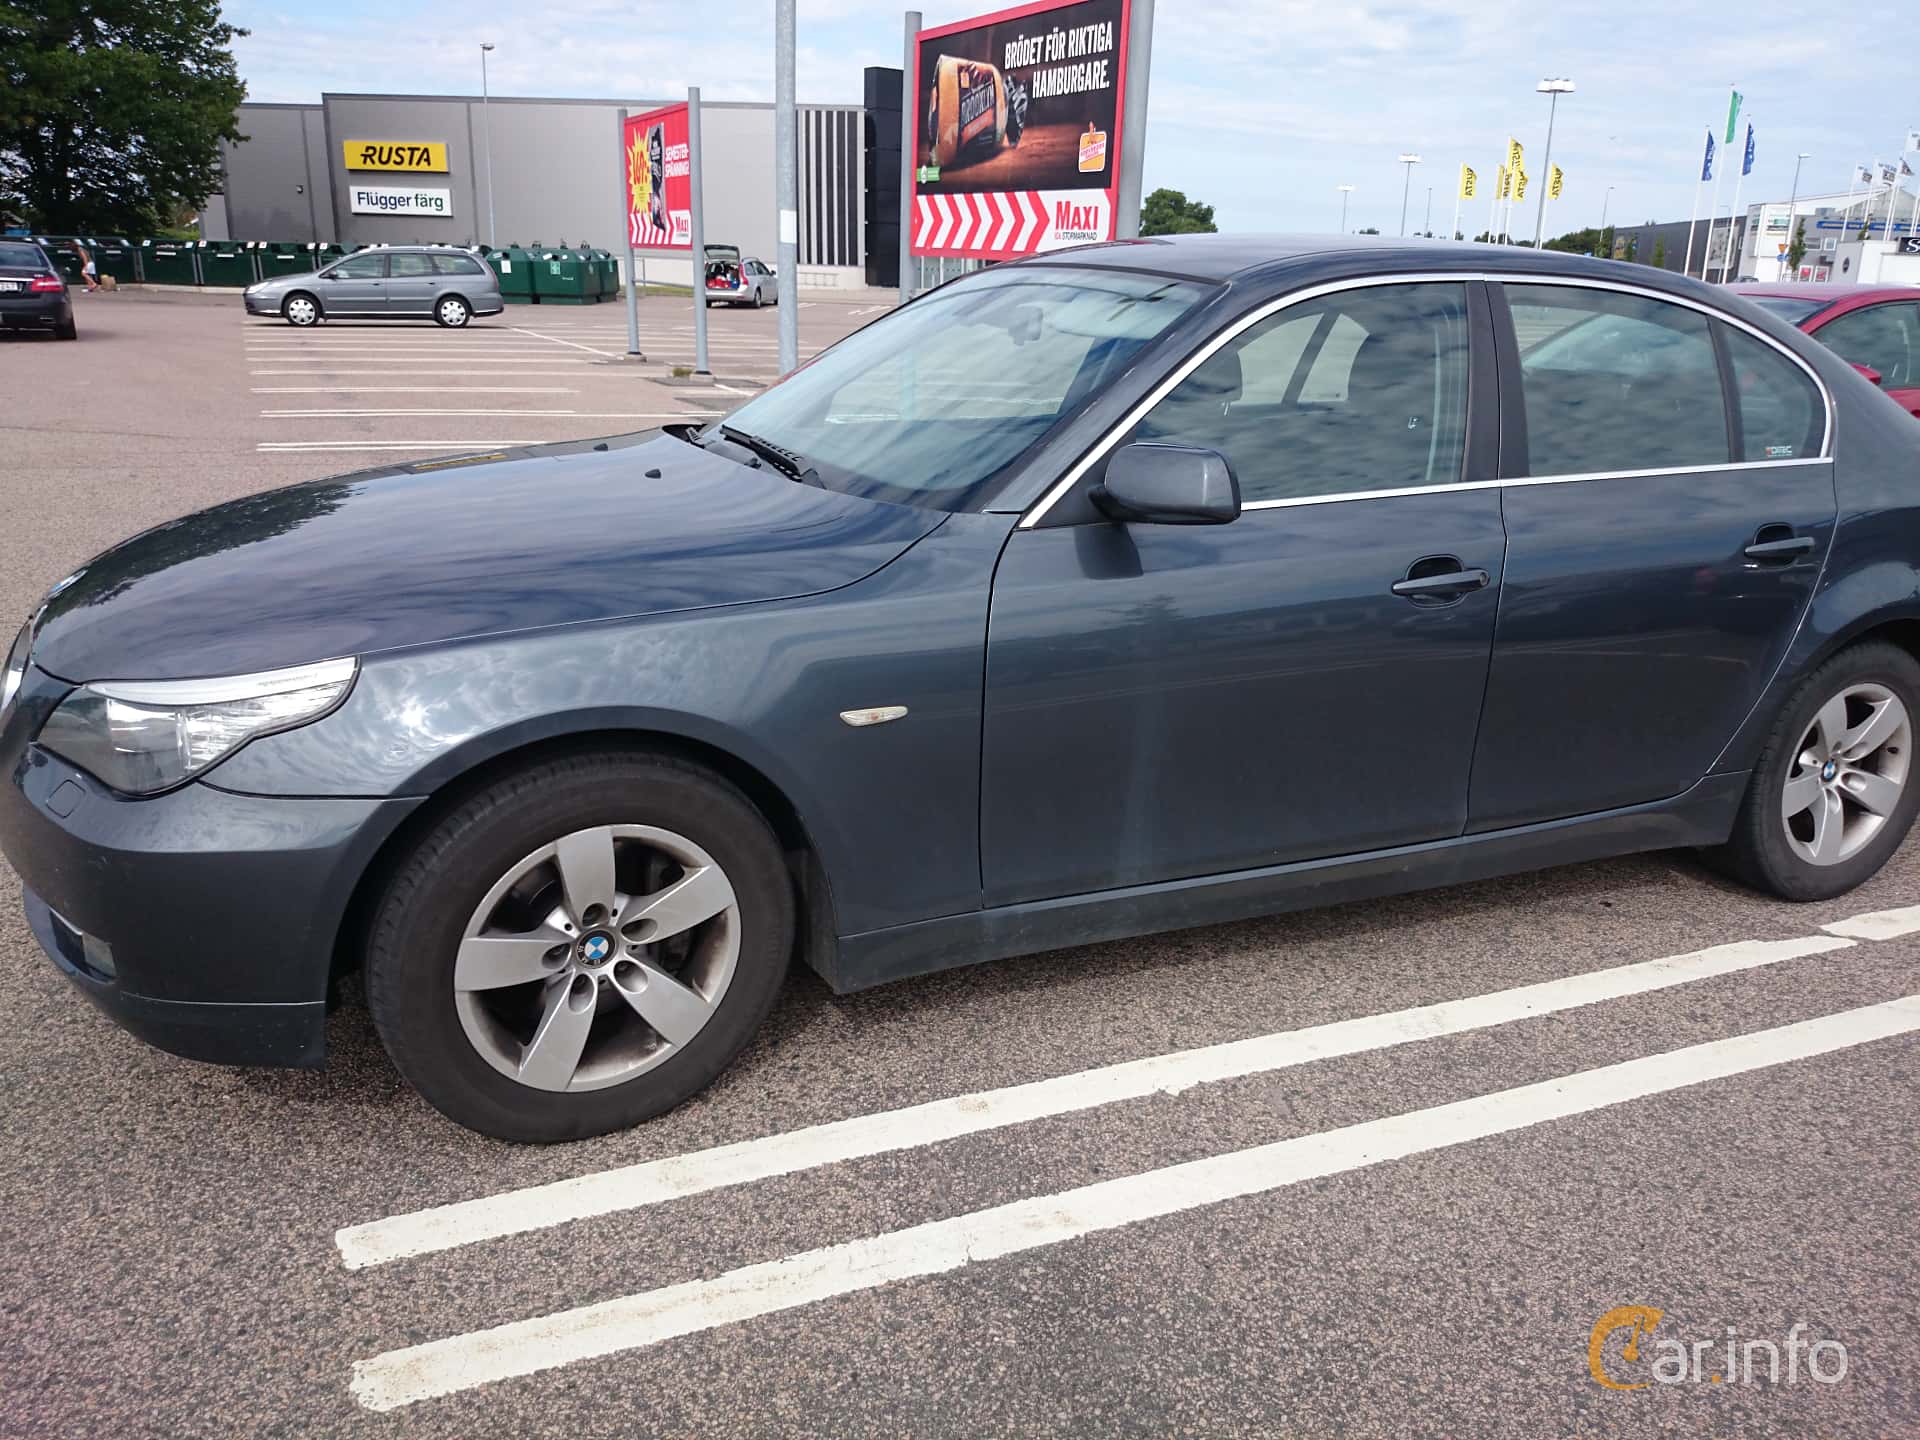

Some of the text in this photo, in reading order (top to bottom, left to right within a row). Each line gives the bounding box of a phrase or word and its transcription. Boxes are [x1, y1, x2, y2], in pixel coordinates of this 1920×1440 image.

[1004, 21, 1113, 70] BRÖDET FÖR RIKTIGA
[1032, 59, 1110, 99] HAMBURGARE.
[360, 145, 431, 167] RUSTA
[357, 191, 444, 211] Flügger färg
